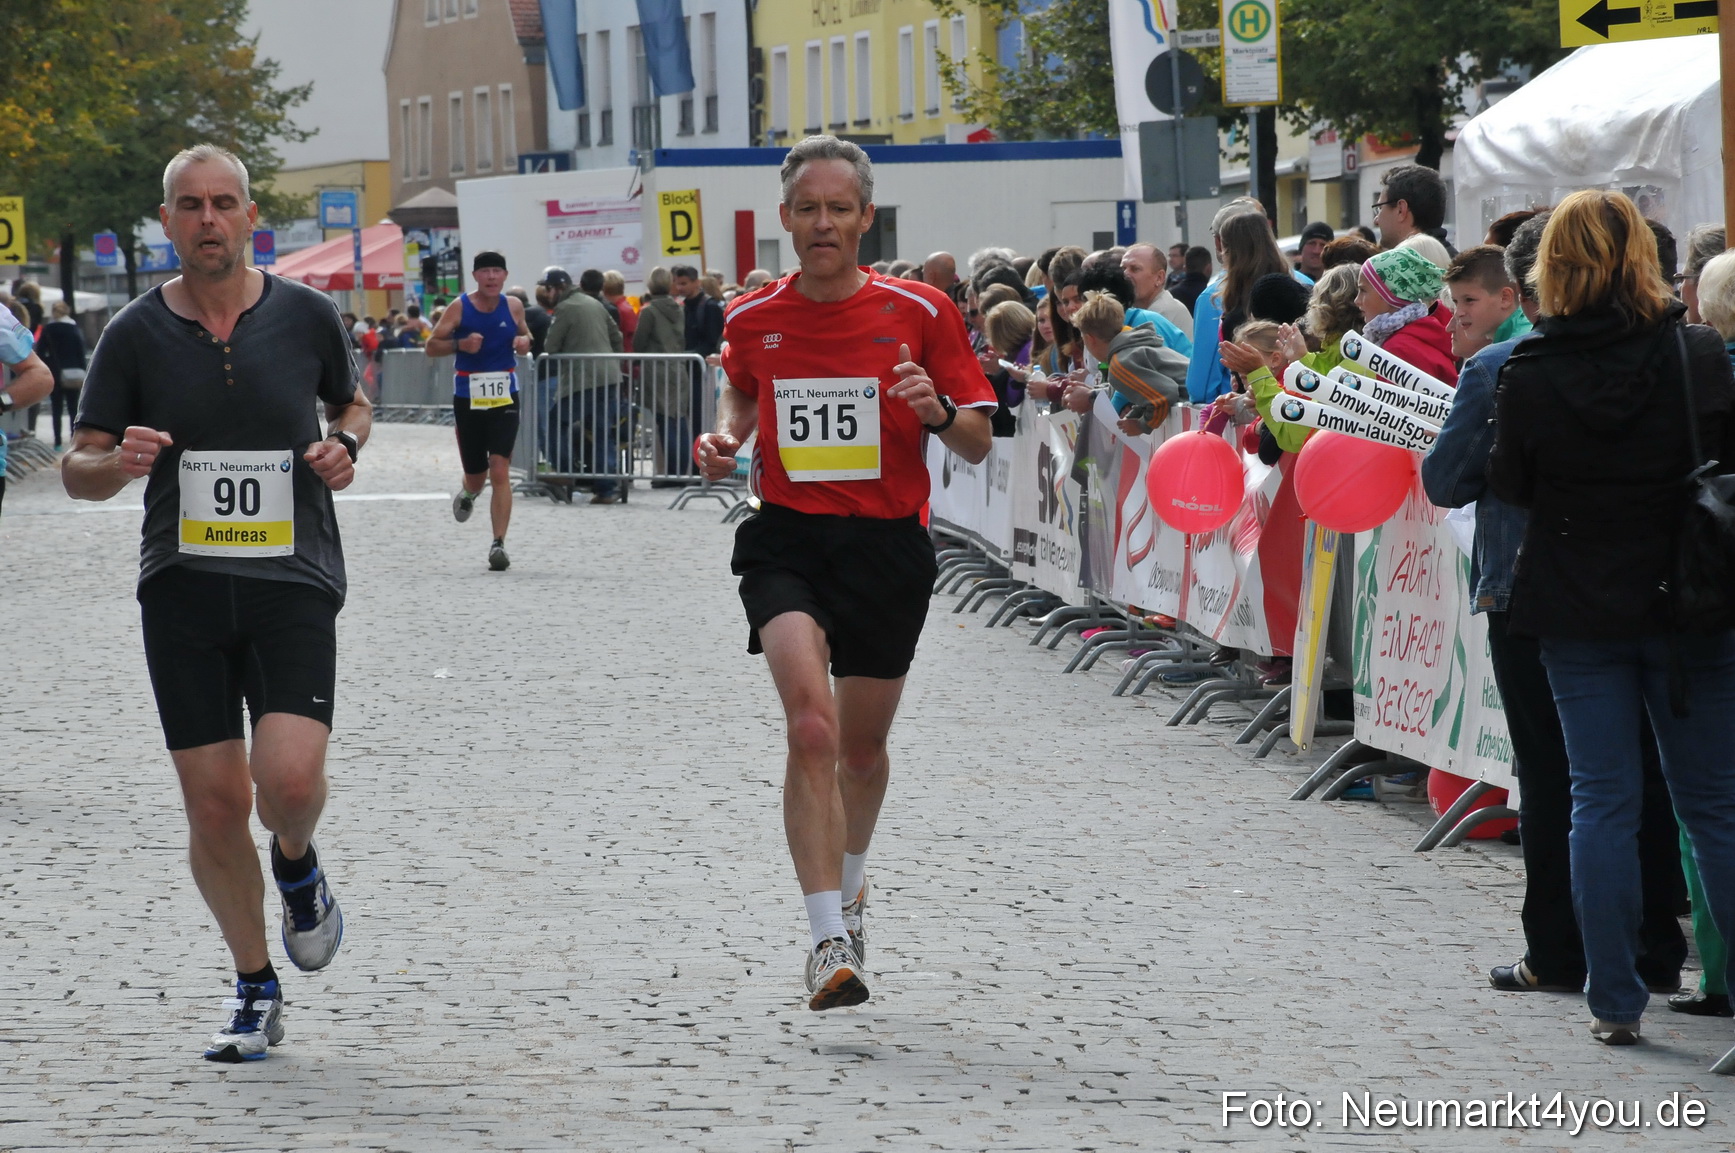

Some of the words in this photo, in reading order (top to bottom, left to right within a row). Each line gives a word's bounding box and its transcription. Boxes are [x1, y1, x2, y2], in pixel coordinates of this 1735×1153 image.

[1239, 9, 1260, 33] H
[1232, 48, 1269, 56] Marktplatz
[662, 192, 697, 206] Block
[568, 227, 614, 240] DAHMIT
[670, 210, 693, 242] D
[1369, 354, 1413, 388] BMW
[480, 382, 504, 397] 116
[774, 389, 804, 399] ARTL
[807, 389, 859, 398] Neumarkt
[789, 403, 858, 442] 515
[182, 460, 217, 472] PARTL
[220, 462, 276, 472] Neumarkt
[213, 477, 261, 516] 90
[205, 527, 267, 542] Andreas
[1375, 677, 1433, 737] BESSER
